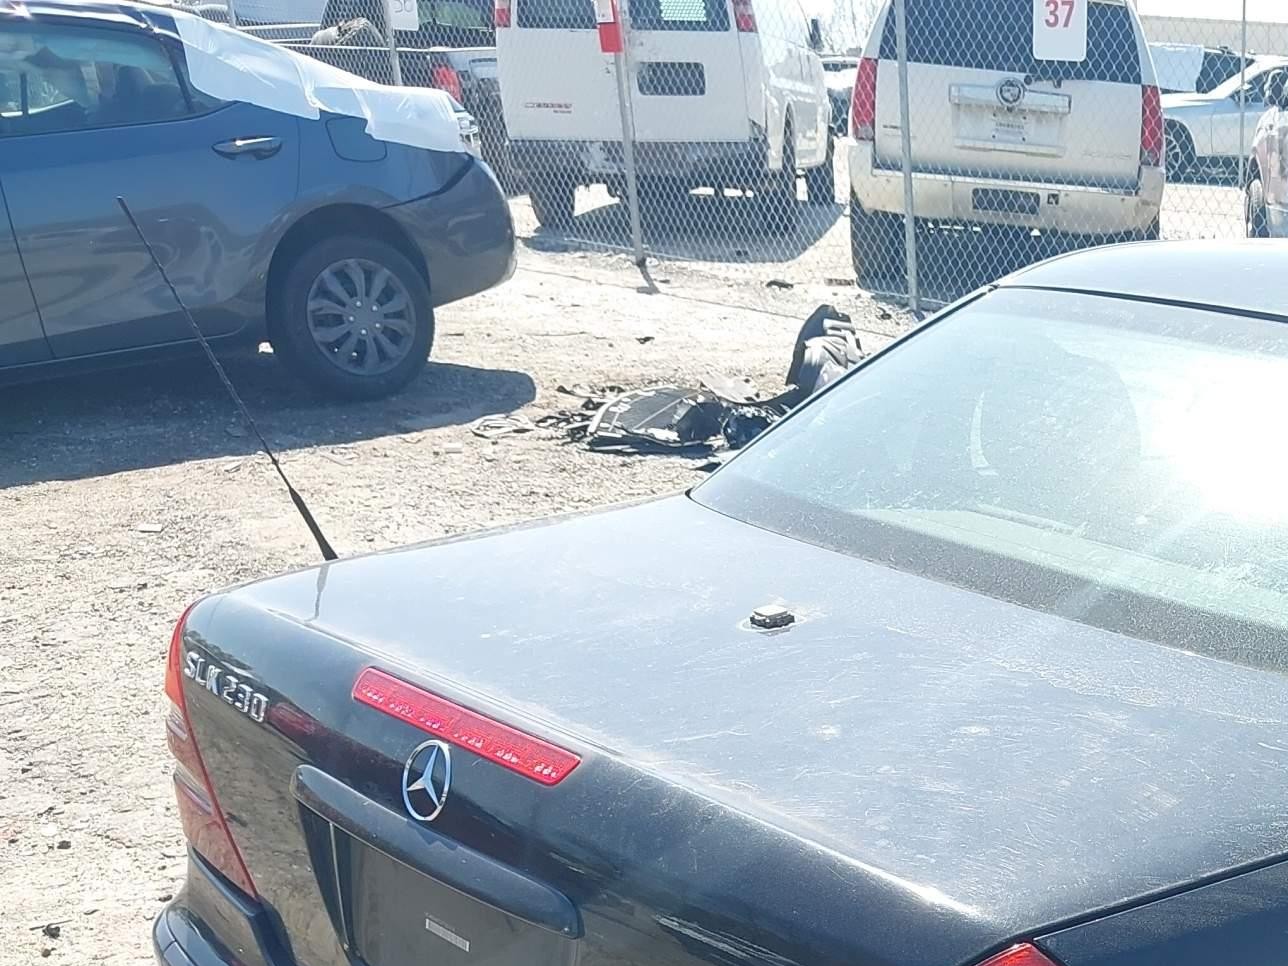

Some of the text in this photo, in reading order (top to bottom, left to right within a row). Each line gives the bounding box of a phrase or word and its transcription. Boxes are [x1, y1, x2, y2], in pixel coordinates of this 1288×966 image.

[1045, 0, 1075, 28] 37
[184, 651, 269, 722] SLK 230
